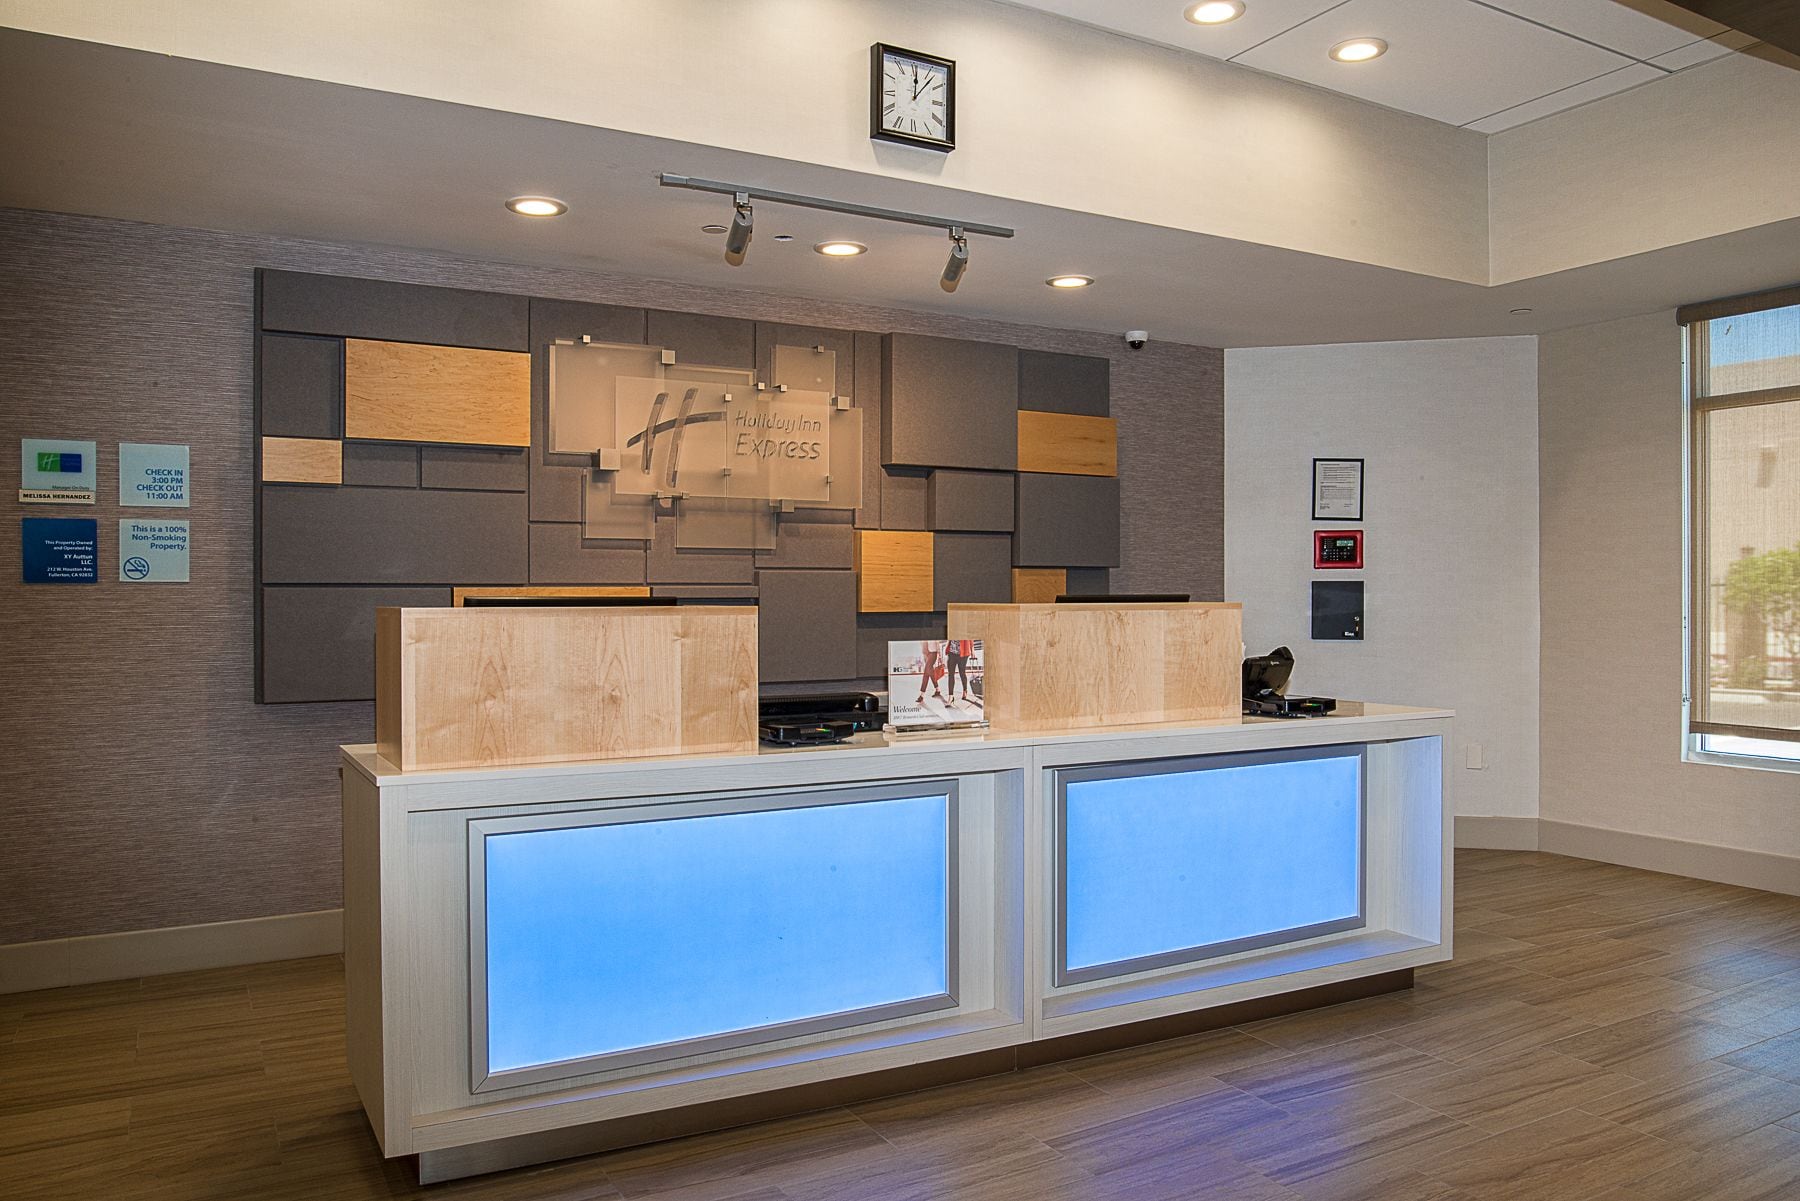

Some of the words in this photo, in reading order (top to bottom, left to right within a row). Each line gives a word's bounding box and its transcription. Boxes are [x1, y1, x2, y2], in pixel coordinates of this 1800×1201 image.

[735, 409, 796, 433] Holiday
[798, 413, 822, 432] Inn
[735, 432, 822, 463] Express
[145, 468, 173, 476] CHECK
[151, 476, 169, 484] 3:00
[136, 483, 164, 491] CHECK
[146, 492, 169, 500] 11:00
[131, 533, 187, 543] Non-Smoking
[150, 542, 187, 550] Property.
[893, 705, 922, 713] Welcome
